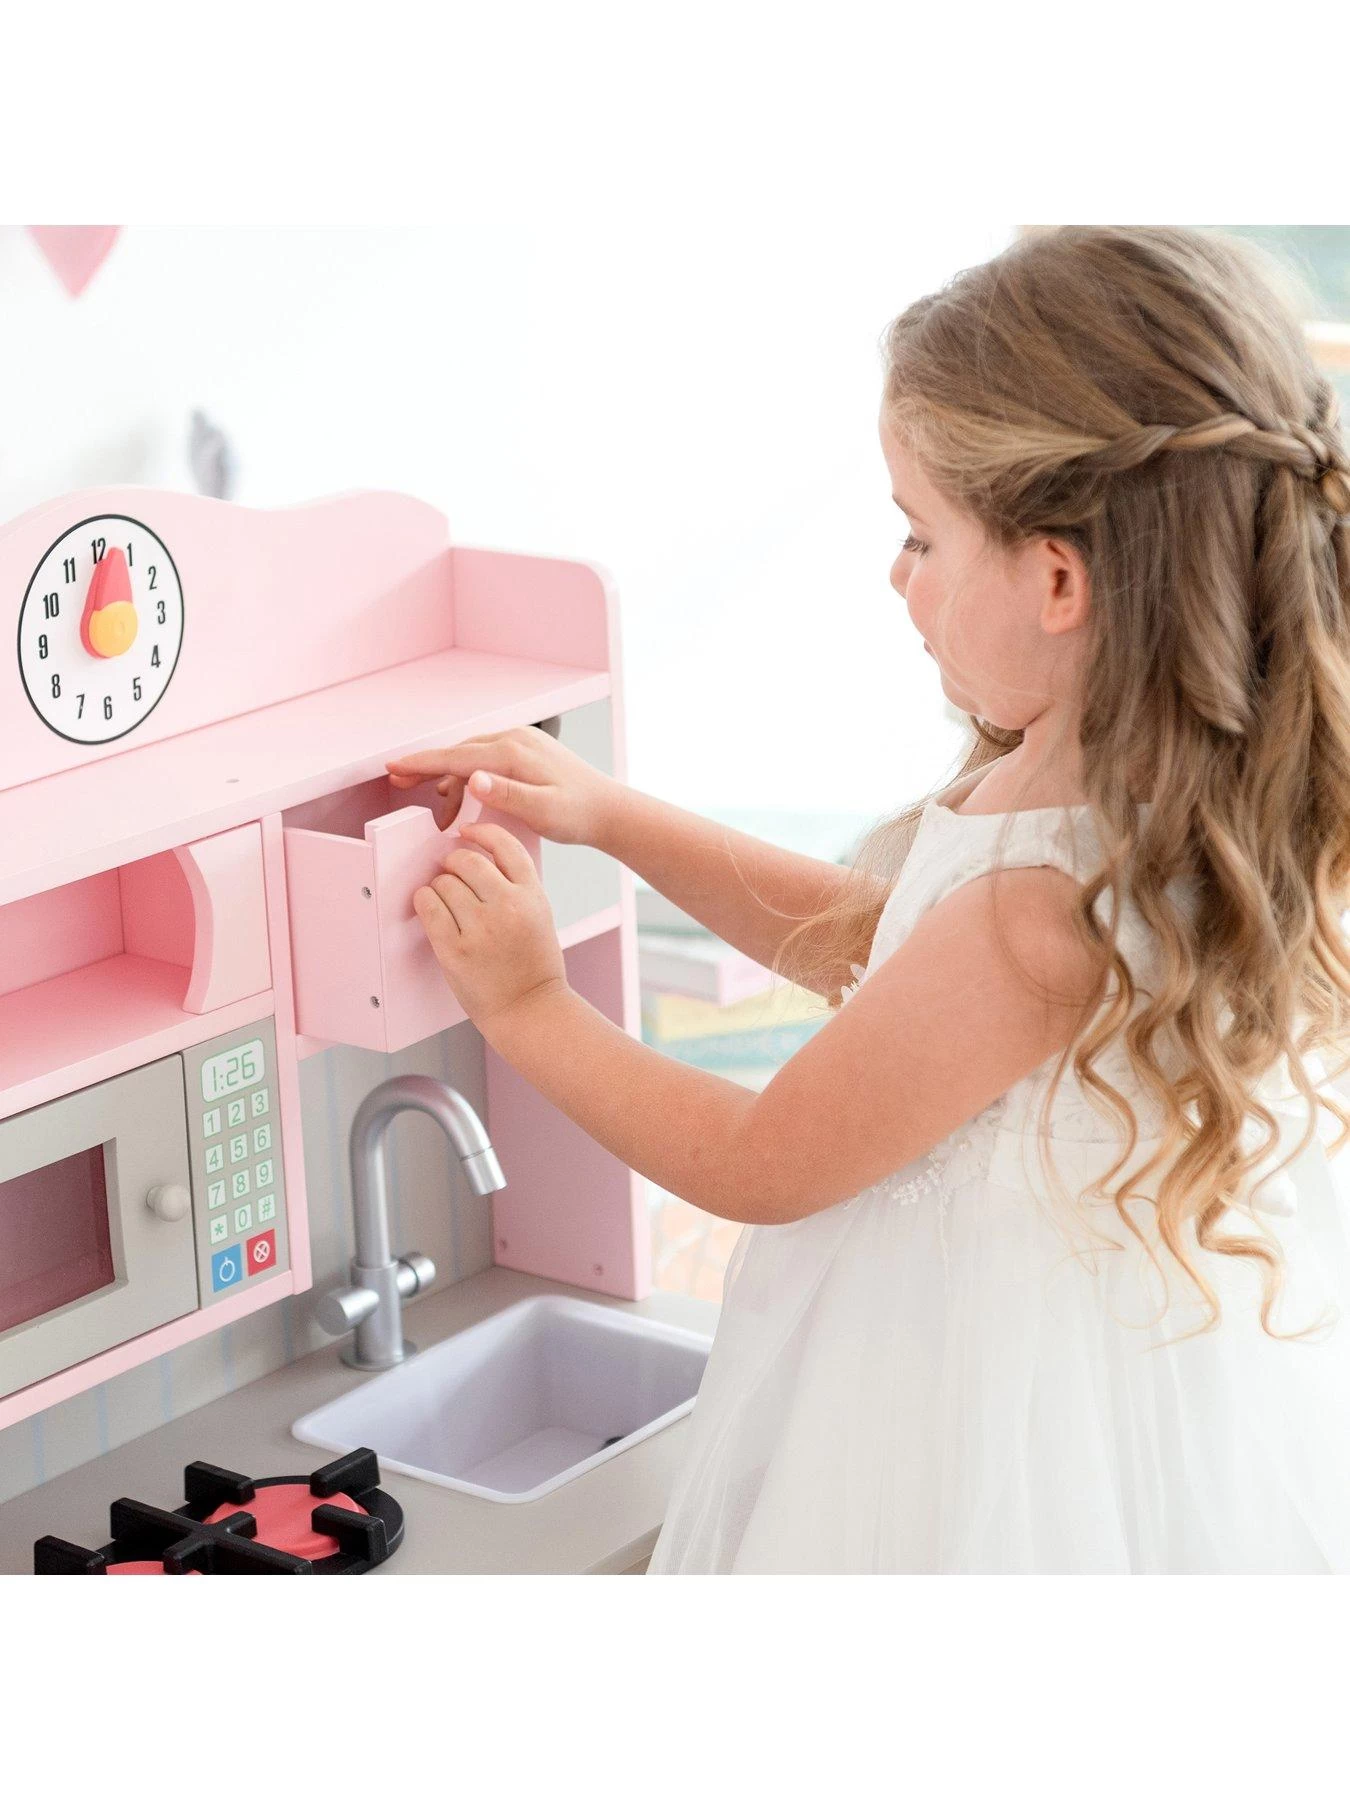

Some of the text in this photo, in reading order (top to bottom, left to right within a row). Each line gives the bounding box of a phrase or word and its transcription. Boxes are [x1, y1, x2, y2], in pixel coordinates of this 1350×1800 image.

[91, 538, 106, 564] 12
[127, 543, 133, 566] 1
[63, 557, 76, 583] 11
[148, 566, 157, 590] 2
[43, 593, 60, 619] 10
[157, 601, 166, 624] 3
[38, 634, 49, 659] 9
[151, 645, 161, 668] 4
[51, 674, 61, 698] 8
[133, 677, 142, 701] 5
[76, 694, 85, 719] 7
[104, 696, 113, 720] 6
[212, 1051, 256, 1092] 1:26
[207, 1094, 265, 1132] 1 2 3
[209, 1129, 266, 1168] 4 5 6
[211, 1164, 268, 1204] 7 8 9
[238, 1209, 247, 1227] 0
[262, 1198, 271, 1217] #
